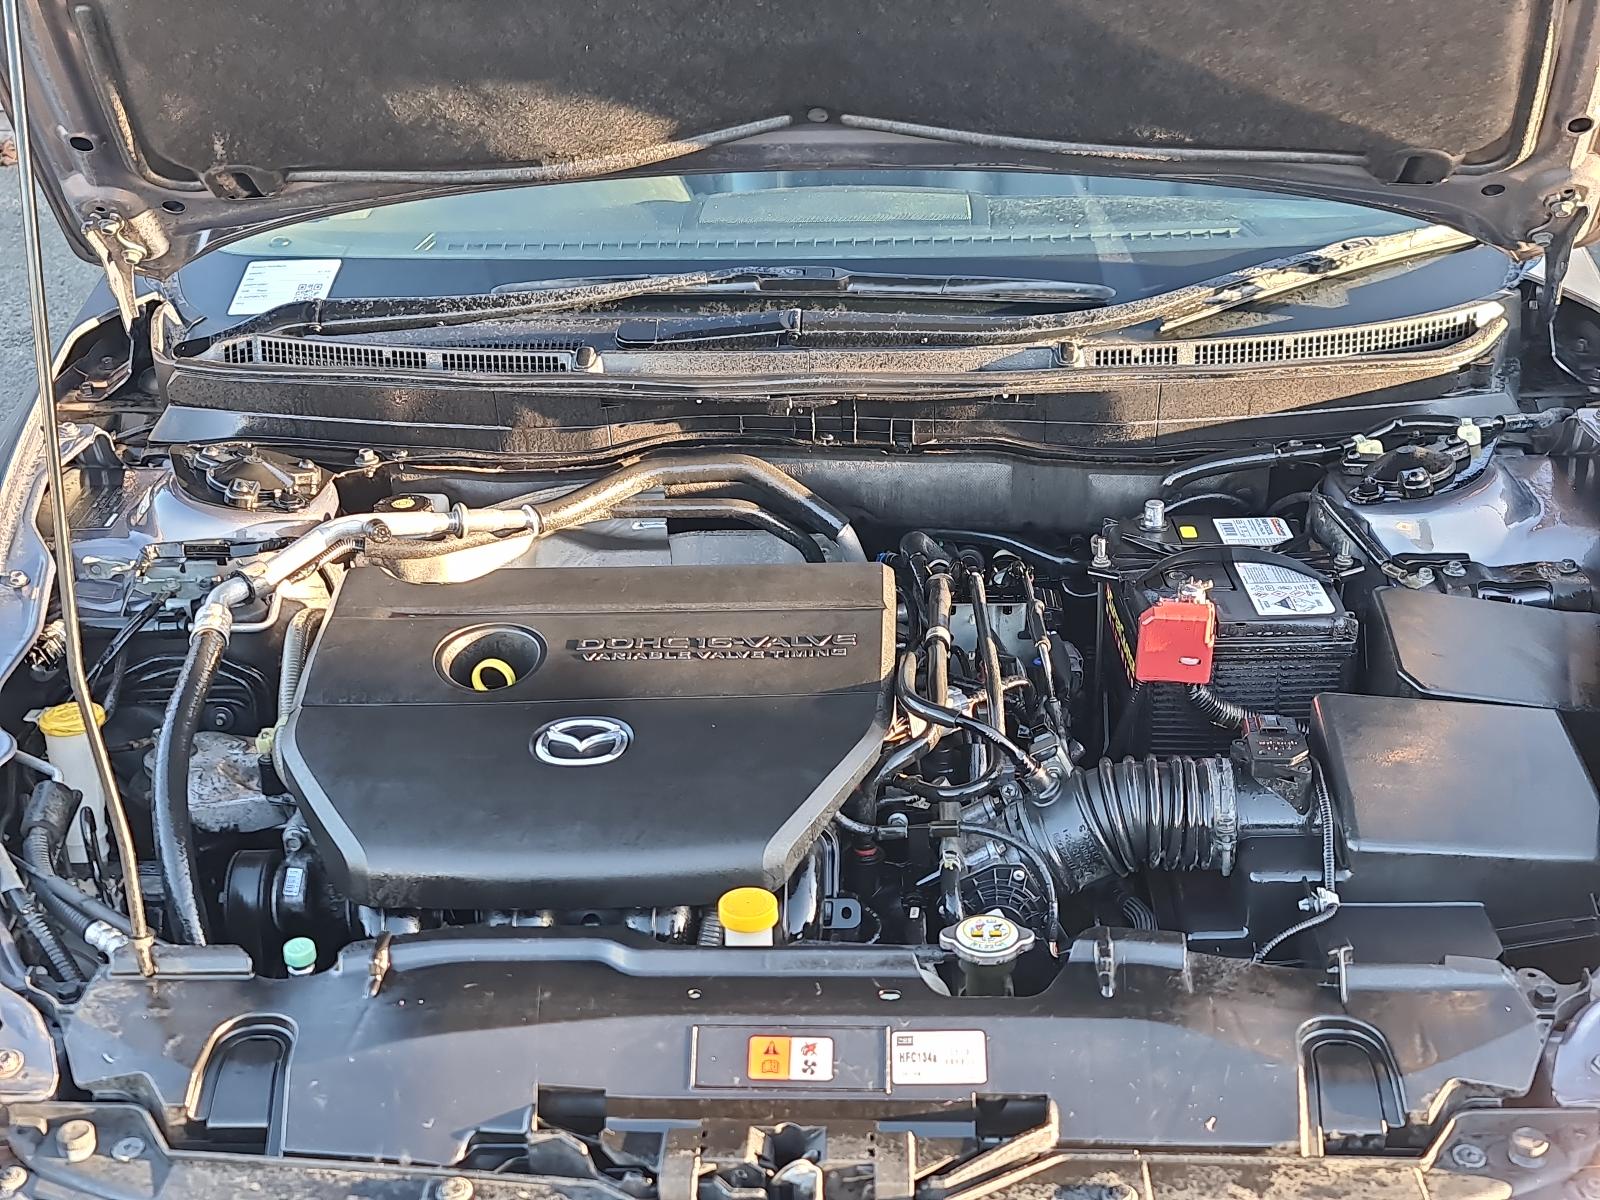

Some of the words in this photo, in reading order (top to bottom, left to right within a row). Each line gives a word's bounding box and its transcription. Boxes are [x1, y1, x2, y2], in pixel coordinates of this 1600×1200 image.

[576, 637, 690, 650] DOHC
[696, 633, 857, 648] 16-VALVE
[582, 651, 691, 661] VARIABLE
[696, 650, 765, 660] VALVE
[769, 647, 847, 659] TIMING
[899, 1051, 937, 1063] HFC134a
